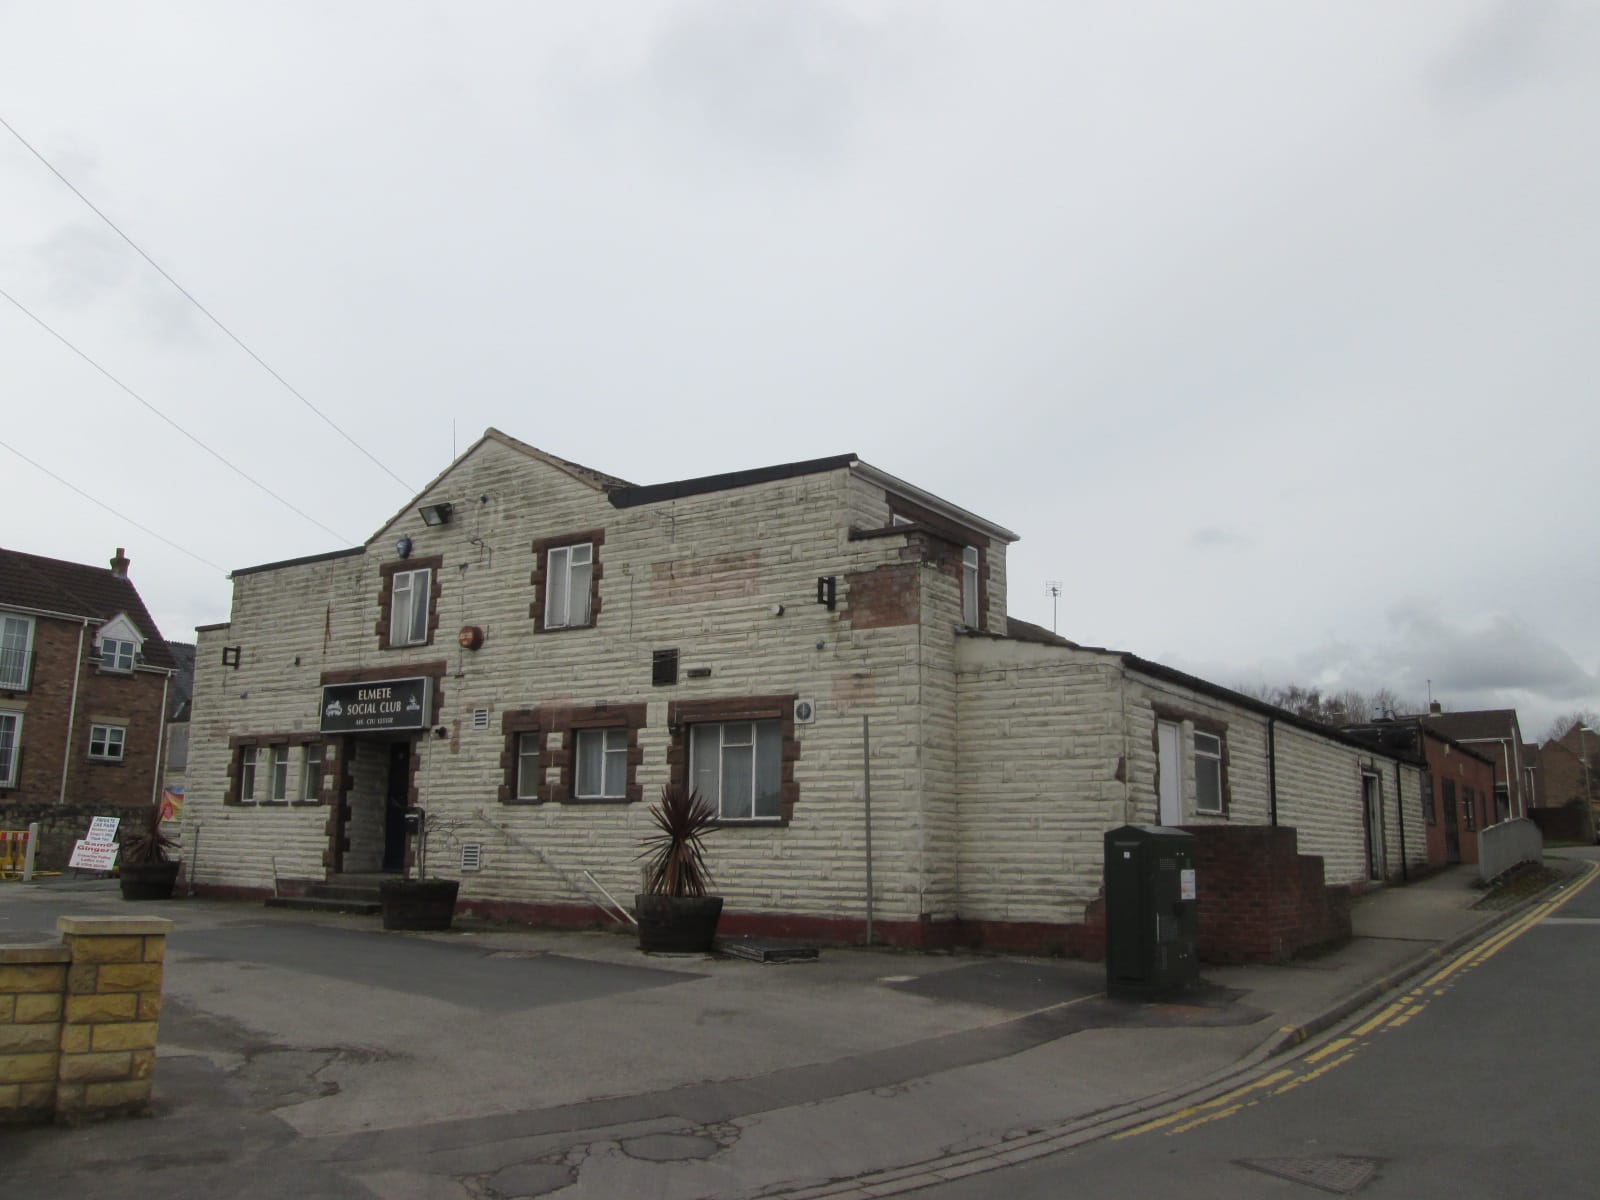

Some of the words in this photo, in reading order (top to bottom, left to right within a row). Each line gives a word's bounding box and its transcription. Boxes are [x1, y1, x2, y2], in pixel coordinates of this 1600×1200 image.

[358, 688, 392, 700] ELMETE
[347, 702, 377, 716] SOCIAL
[380, 701, 402, 714] CLUB
